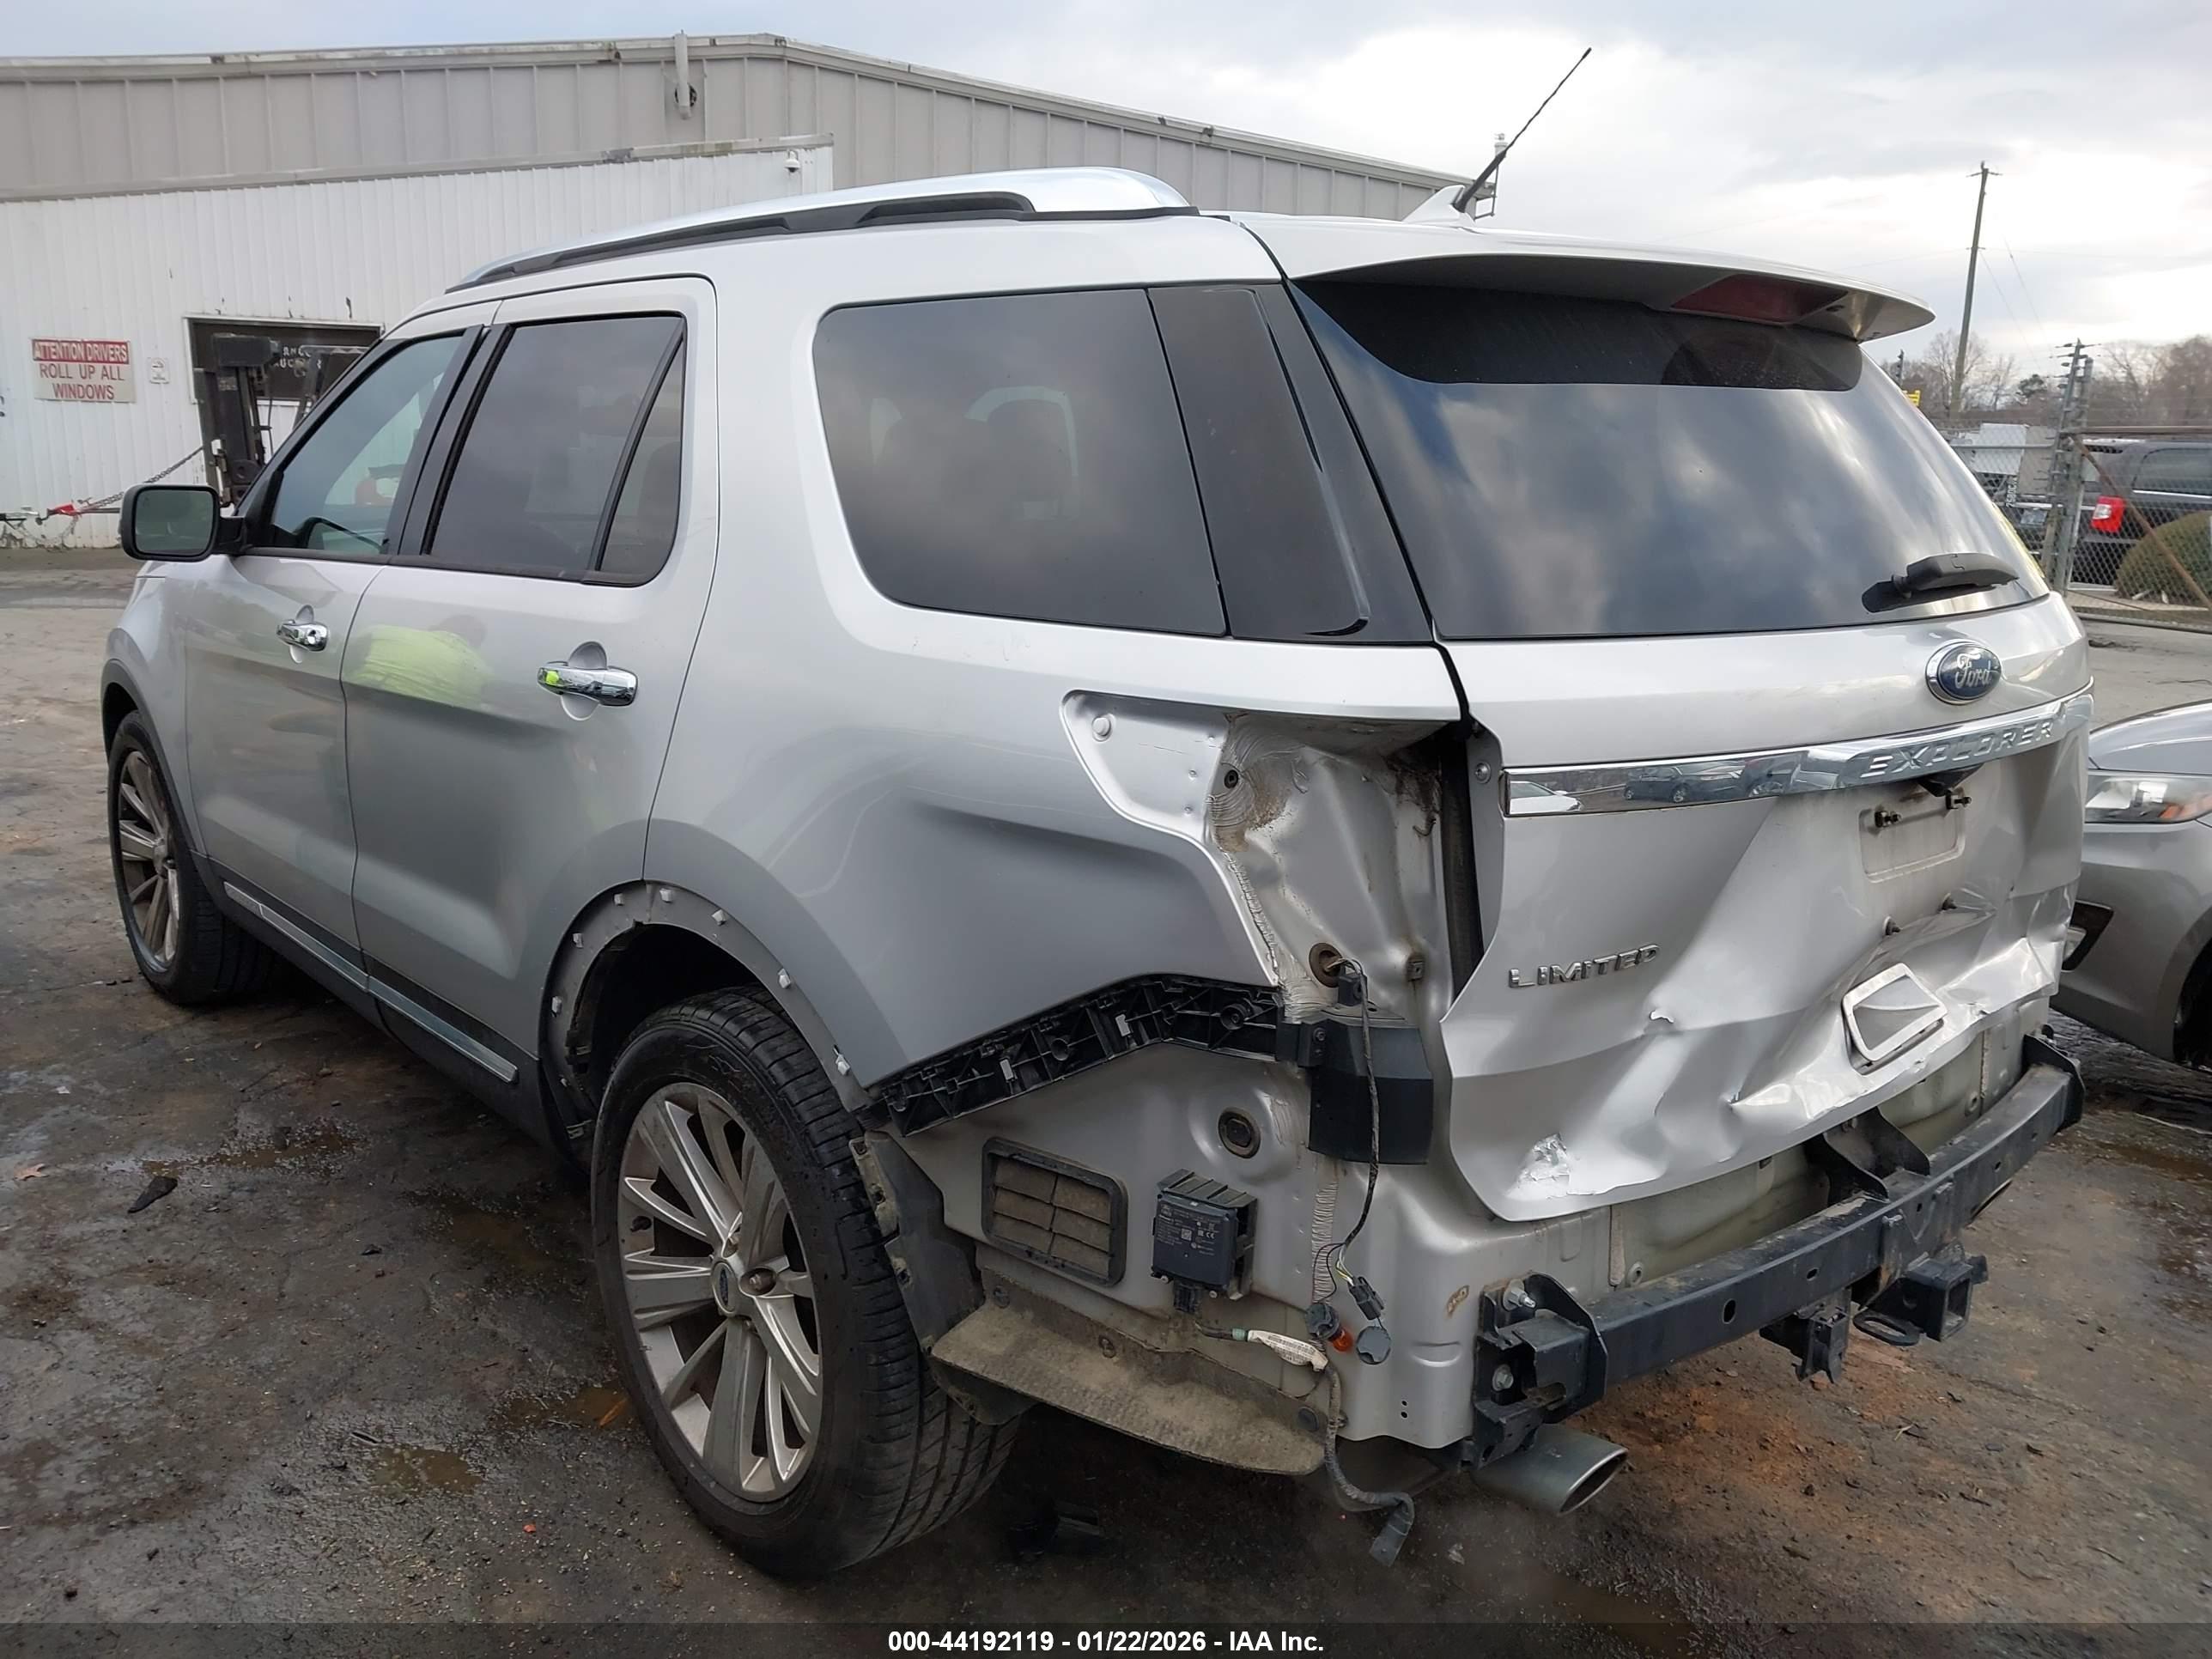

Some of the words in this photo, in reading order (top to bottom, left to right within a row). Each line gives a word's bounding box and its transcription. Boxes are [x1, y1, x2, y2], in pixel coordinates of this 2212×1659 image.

[33, 342, 84, 361] ATTENTION
[87, 344, 127, 362] DRIVERS
[40, 363, 72, 378] ROLL
[79, 364, 95, 380] UP
[101, 365, 125, 380] ALL
[52, 383, 115, 400] WINDOWS
[1954, 652, 1995, 689] Ford
[1859, 721, 2053, 778] EXPLORER
[1509, 944, 1661, 988] LIMITED
